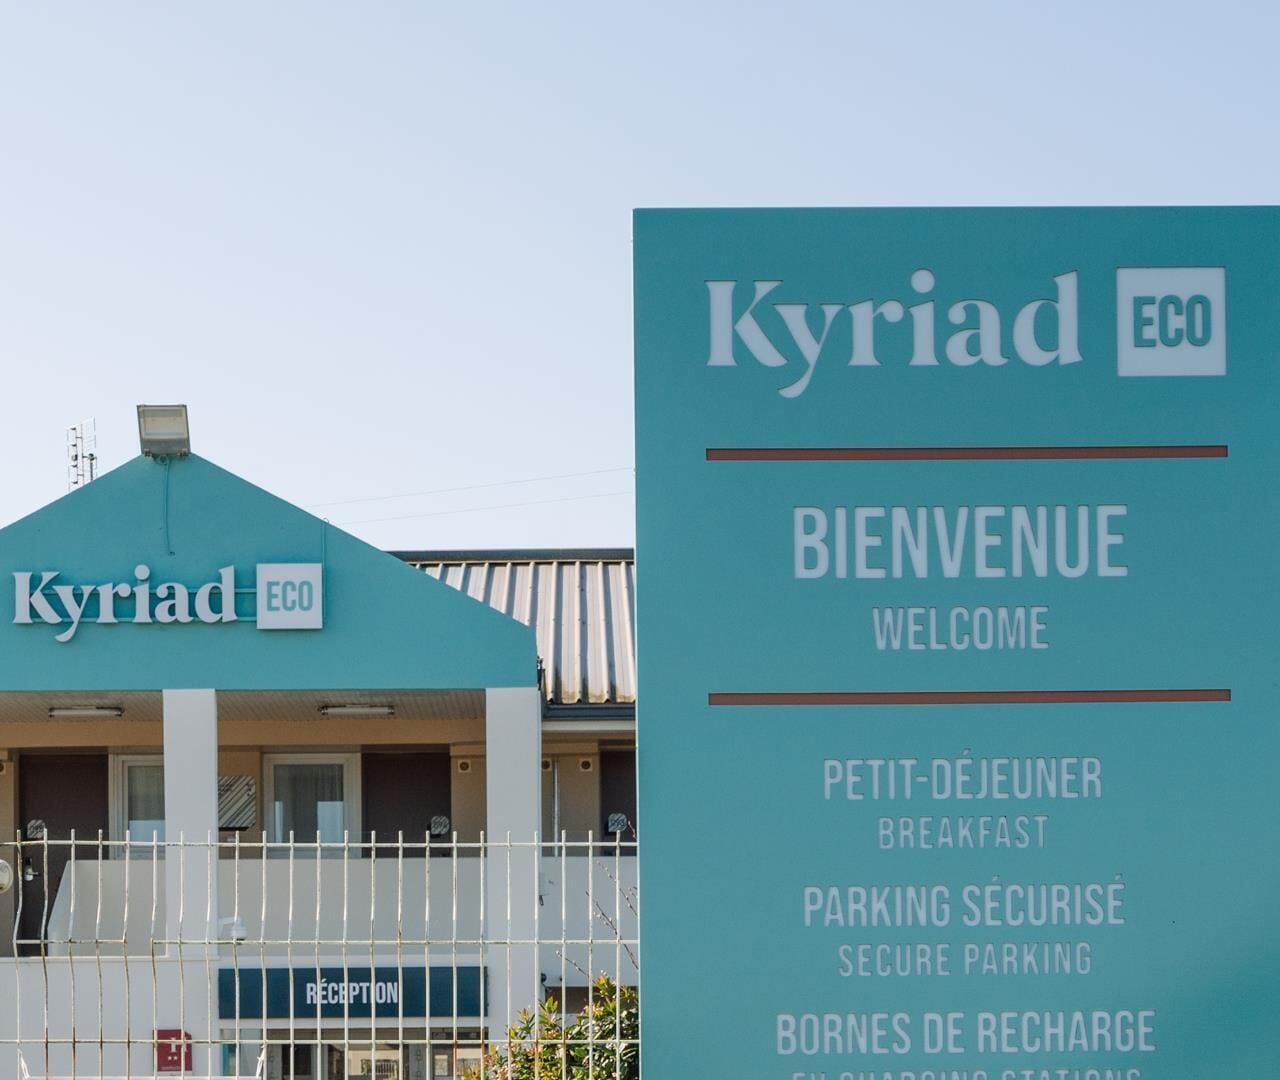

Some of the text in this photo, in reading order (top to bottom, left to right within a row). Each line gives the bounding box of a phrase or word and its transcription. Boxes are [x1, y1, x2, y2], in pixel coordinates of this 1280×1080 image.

[706, 269, 1212, 398] Kyriad ECO
[793, 504, 1129, 579] BIENVENUE
[12, 565, 313, 641] Kyriad ECO
[873, 606, 1049, 650] WELCOME
[824, 749, 1102, 800] PETIT-DÉJEUNER
[878, 816, 1048, 849] BREAKFAST
[804, 875, 1126, 926] PARKING SÉCURISÉ
[838, 943, 1092, 976] SECURE PARKING
[306, 978, 398, 1004] RÉCEPTON
[776, 1010, 1157, 1054] BORNES DE RECHARGE
